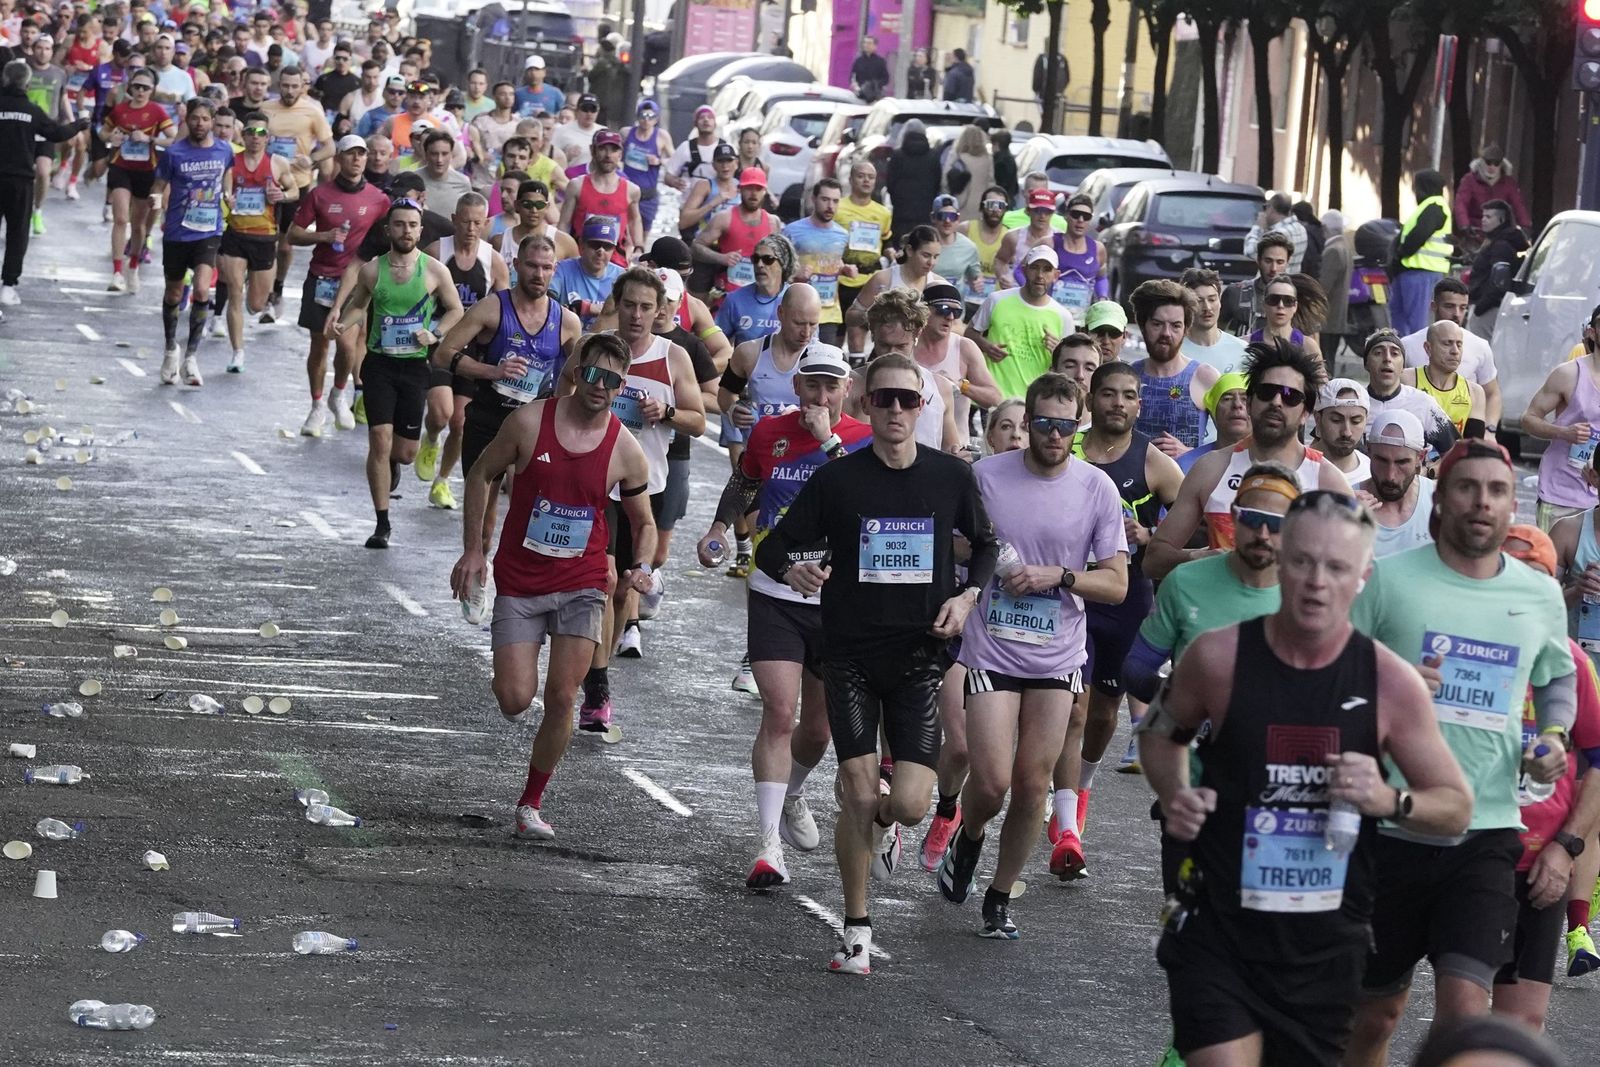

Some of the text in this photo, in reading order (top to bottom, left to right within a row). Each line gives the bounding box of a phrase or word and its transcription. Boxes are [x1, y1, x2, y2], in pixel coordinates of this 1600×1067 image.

[0, 111, 32, 122] LUNTEER
[395, 336, 412, 345] BEN
[554, 506, 588, 518] ZURICH
[551, 522, 570, 533] 6303
[884, 522, 925, 531] ZURICH
[544, 531, 571, 546] LUIS
[885, 541, 907, 550] 9032
[872, 554, 920, 568] PIERRE
[1013, 600, 1034, 612] 6491
[988, 609, 1055, 632] ALBEROLA
[1456, 642, 1510, 661] ZURICH
[1455, 667, 1482, 682] 7364
[1433, 683, 1495, 708] JULIEN
[1283, 818, 1326, 833] ZURI
[1284, 847, 1316, 862] 7611
[1258, 866, 1333, 887] TREVOR
